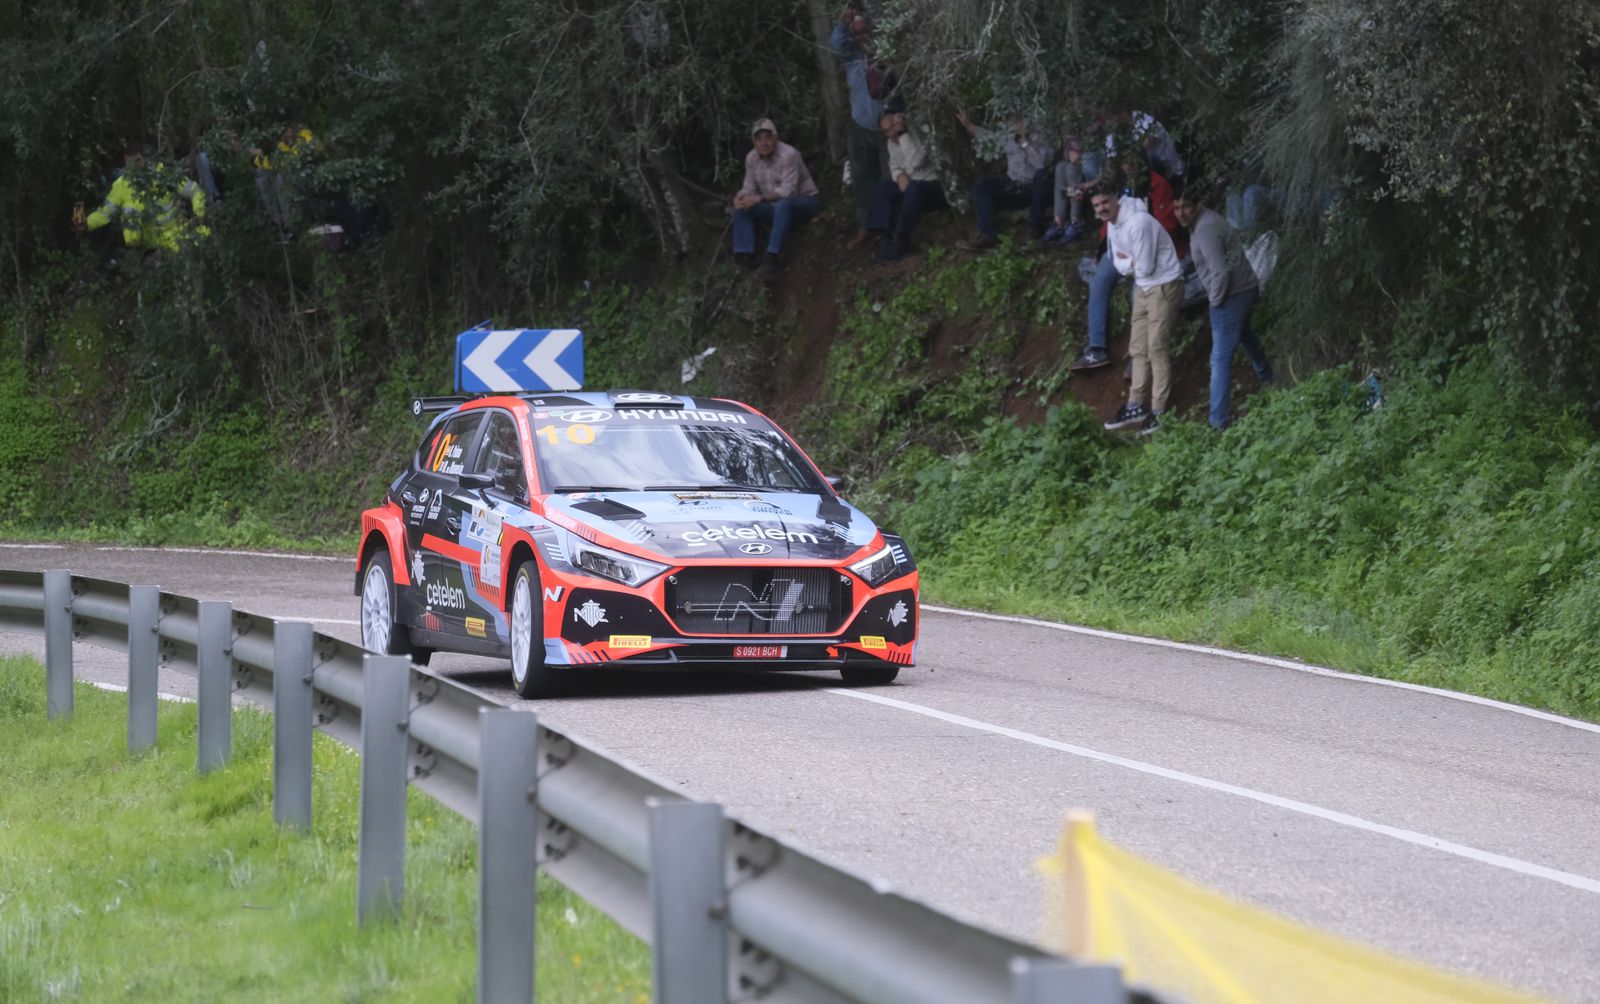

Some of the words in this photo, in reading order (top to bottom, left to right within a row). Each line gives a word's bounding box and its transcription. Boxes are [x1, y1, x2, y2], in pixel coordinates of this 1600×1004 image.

[618, 409, 747, 424] HYUNDAI
[536, 424, 595, 445] 10
[426, 431, 451, 472] 10
[681, 523, 819, 547] cetelem
[426, 577, 466, 610] cetelem
[613, 637, 648, 647] PIRELLI
[735, 646, 742, 656] S
[742, 646, 761, 656] 0921
[762, 646, 778, 656] BCH
